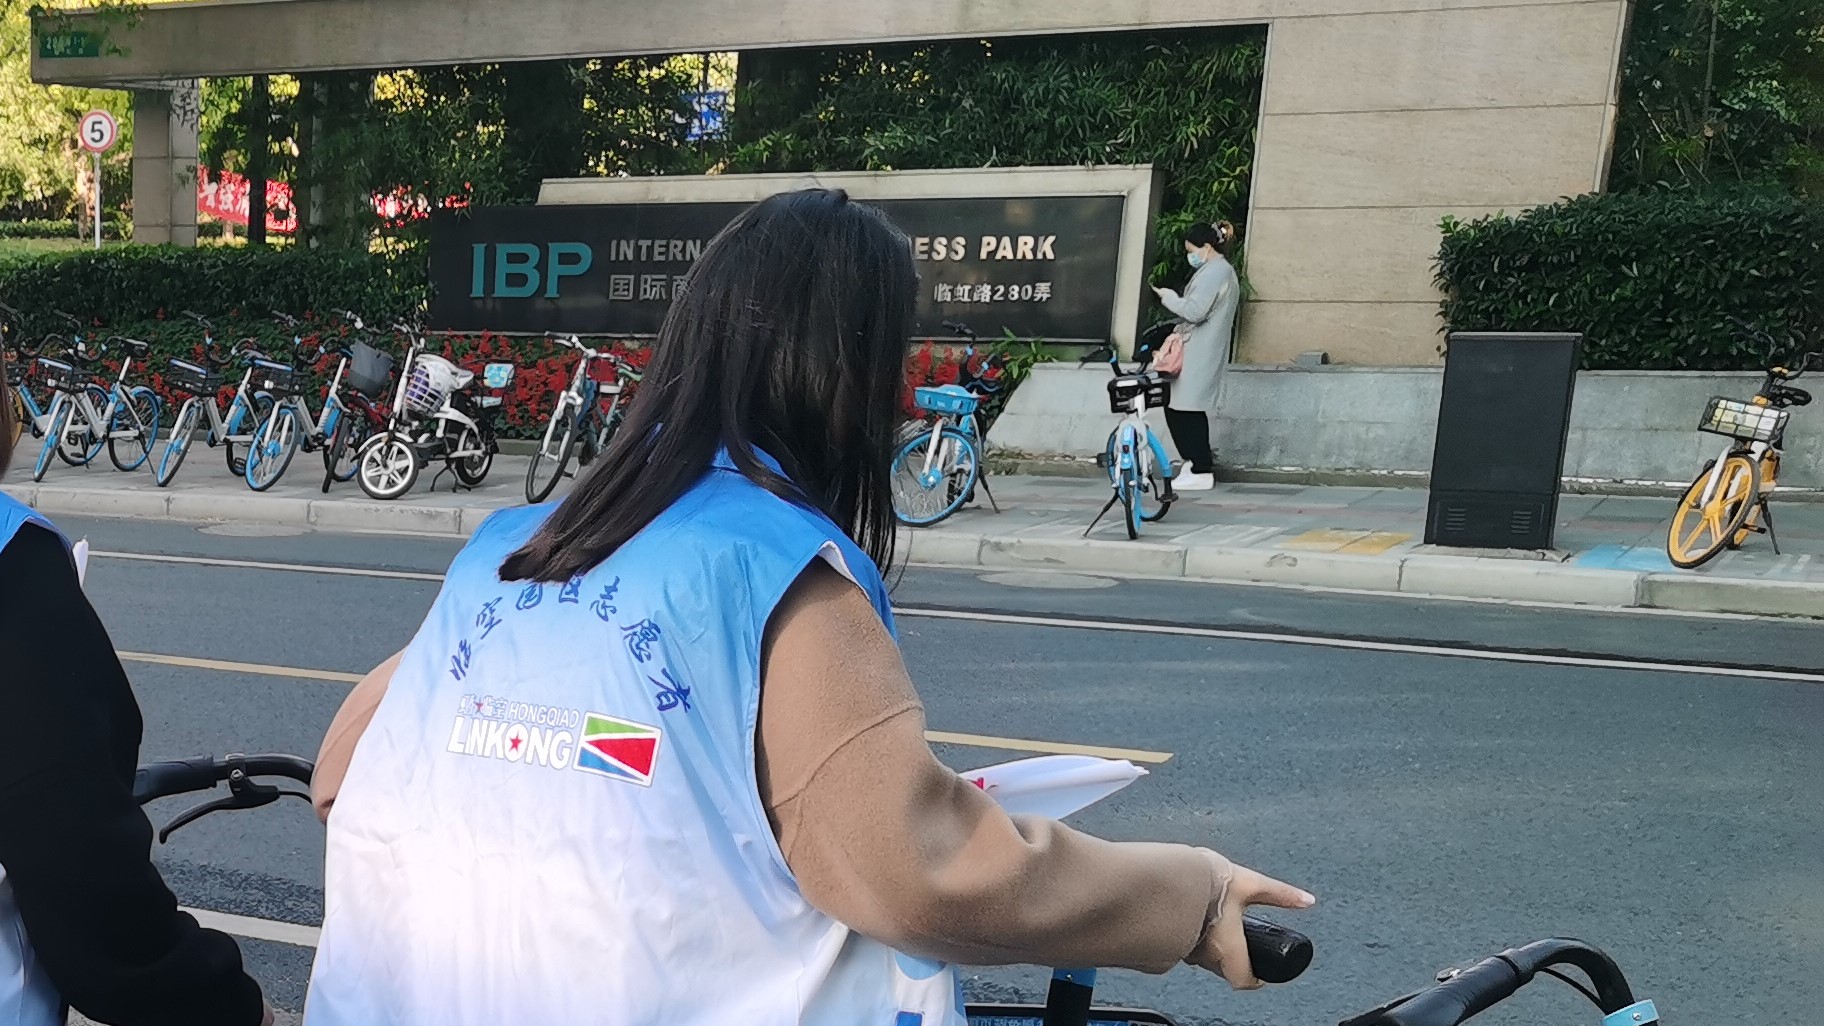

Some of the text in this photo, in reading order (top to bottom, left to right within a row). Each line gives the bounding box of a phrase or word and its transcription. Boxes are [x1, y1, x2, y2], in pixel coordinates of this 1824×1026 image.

[90, 120, 104, 143] 5
[610, 235, 1057, 262] INTERN ESS PARK
[470, 242, 593, 298] IBP
[934, 281, 1052, 304] 临虹路280弄
[508, 701, 580, 729] HONGQIAO
